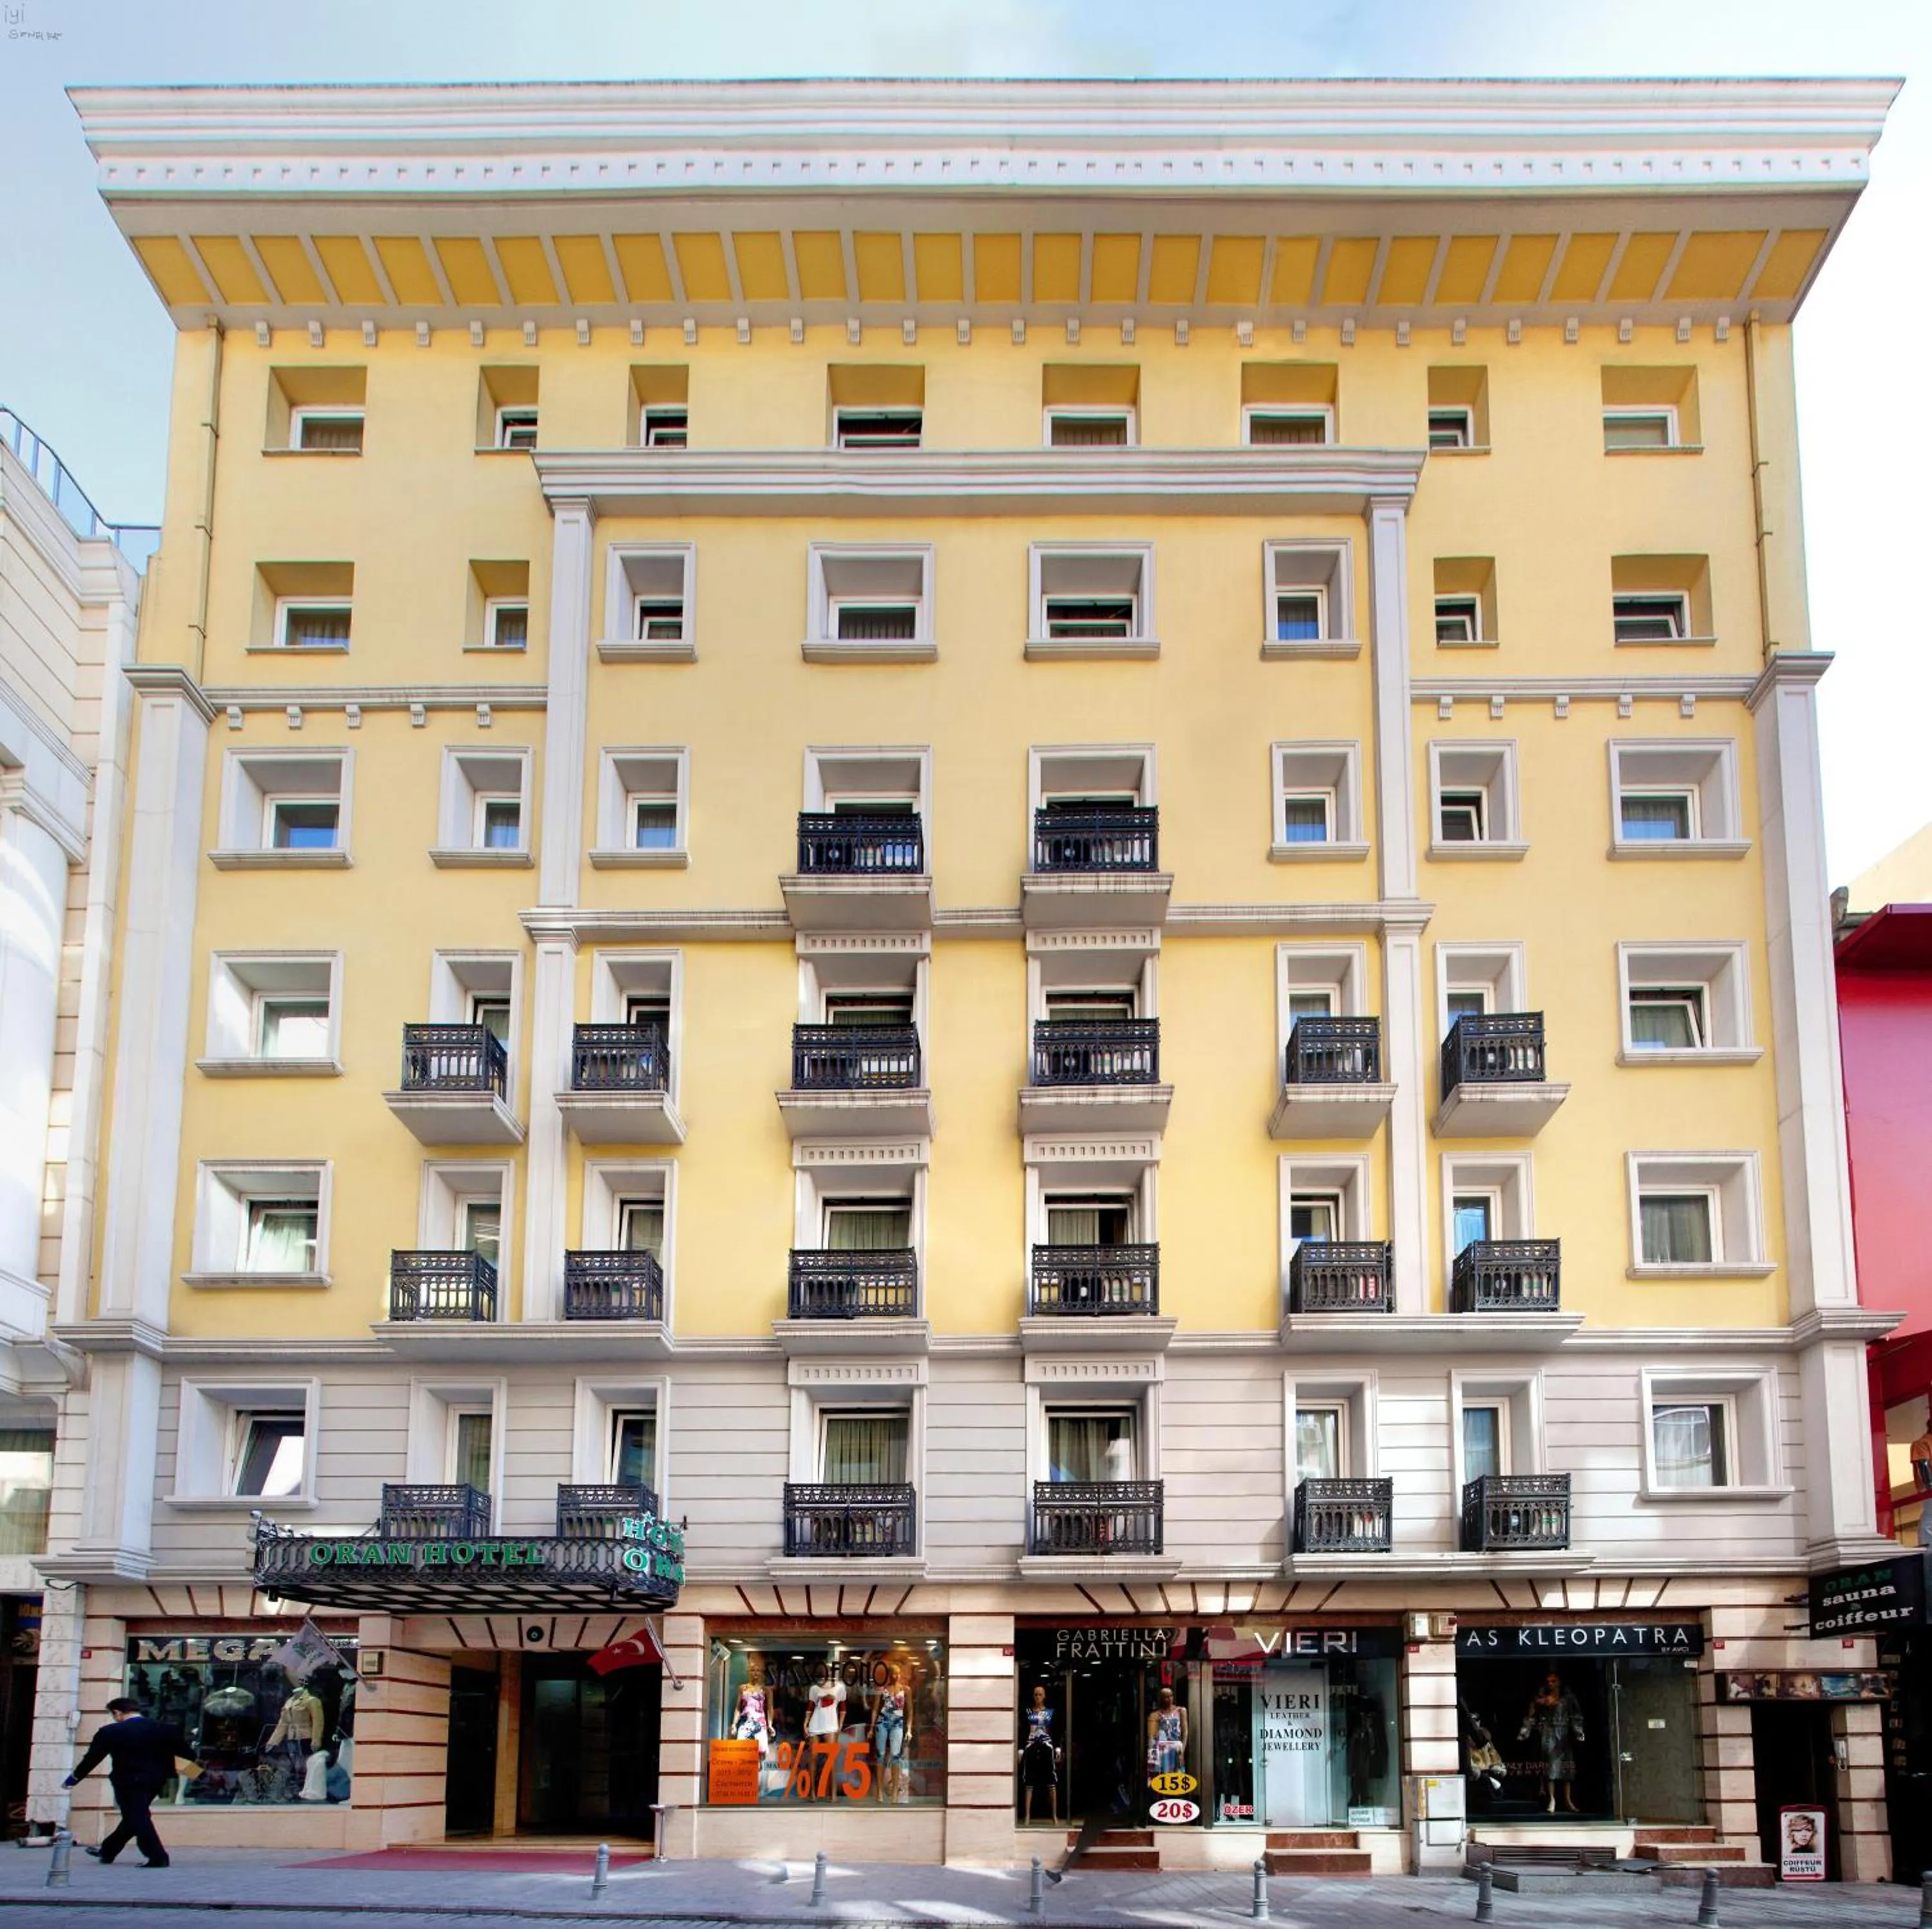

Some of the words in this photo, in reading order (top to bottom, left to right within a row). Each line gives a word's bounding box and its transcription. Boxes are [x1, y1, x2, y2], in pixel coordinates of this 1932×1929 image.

[310, 1544, 412, 1565] ORAN
[424, 1544, 544, 1565] HOTEL
[1825, 1568, 1893, 1592] ORAN
[1822, 1585, 1897, 1606] sauna
[1815, 1606, 1914, 1630] coiffeur
[1057, 1629, 1167, 1641] GABRIELLA
[1254, 1631, 1358, 1653] VIERI
[1466, 1630, 1498, 1646] AS
[1519, 1627, 1689, 1646] KLEOPATRA
[1057, 1642, 1167, 1658] FRATTINI
[1260, 1693, 1320, 1709] VIERI
[1260, 1727, 1322, 1739] DIAMOND
[1262, 1741, 1321, 1751] JEWELLERY
[777, 1741, 871, 1800] %75
[1159, 1776, 1191, 1791] 15$
[1157, 1802, 1193, 1819] 20$
